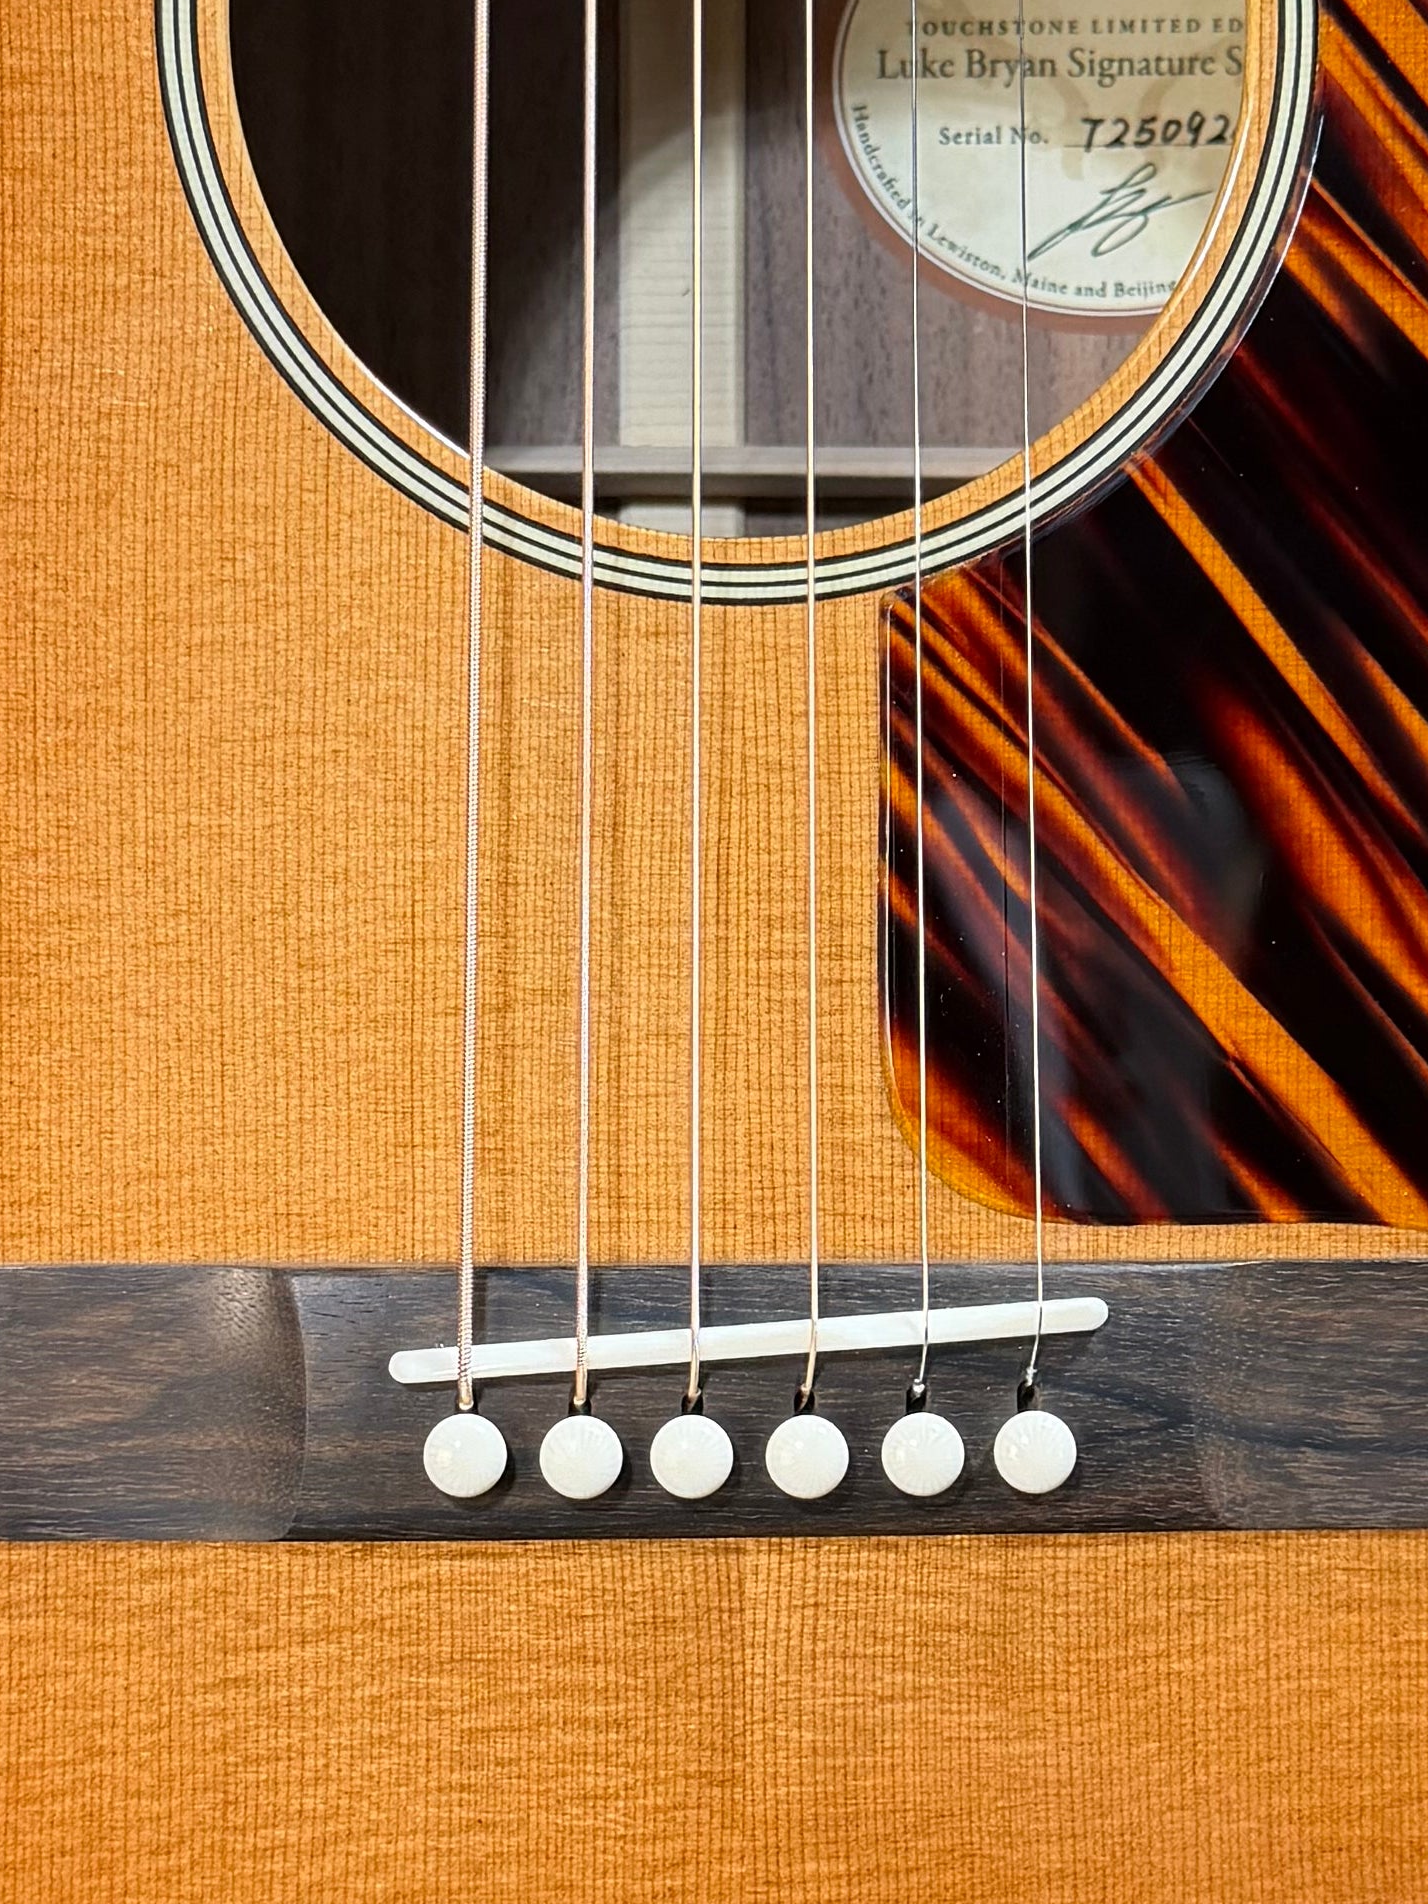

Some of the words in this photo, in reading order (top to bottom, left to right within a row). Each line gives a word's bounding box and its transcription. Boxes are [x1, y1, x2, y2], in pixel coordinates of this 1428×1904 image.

[1091, 18, 1202, 35] LIMITED
[877, 47, 955, 79] Luke
[965, 48, 1057, 89] Bryan
[1067, 47, 1217, 88] Signature
[938, 125, 1002, 146] Serial
[1009, 126, 1050, 145] No.
[1080, 110, 1236, 153] T25092
[1073, 281, 1107, 298] and
